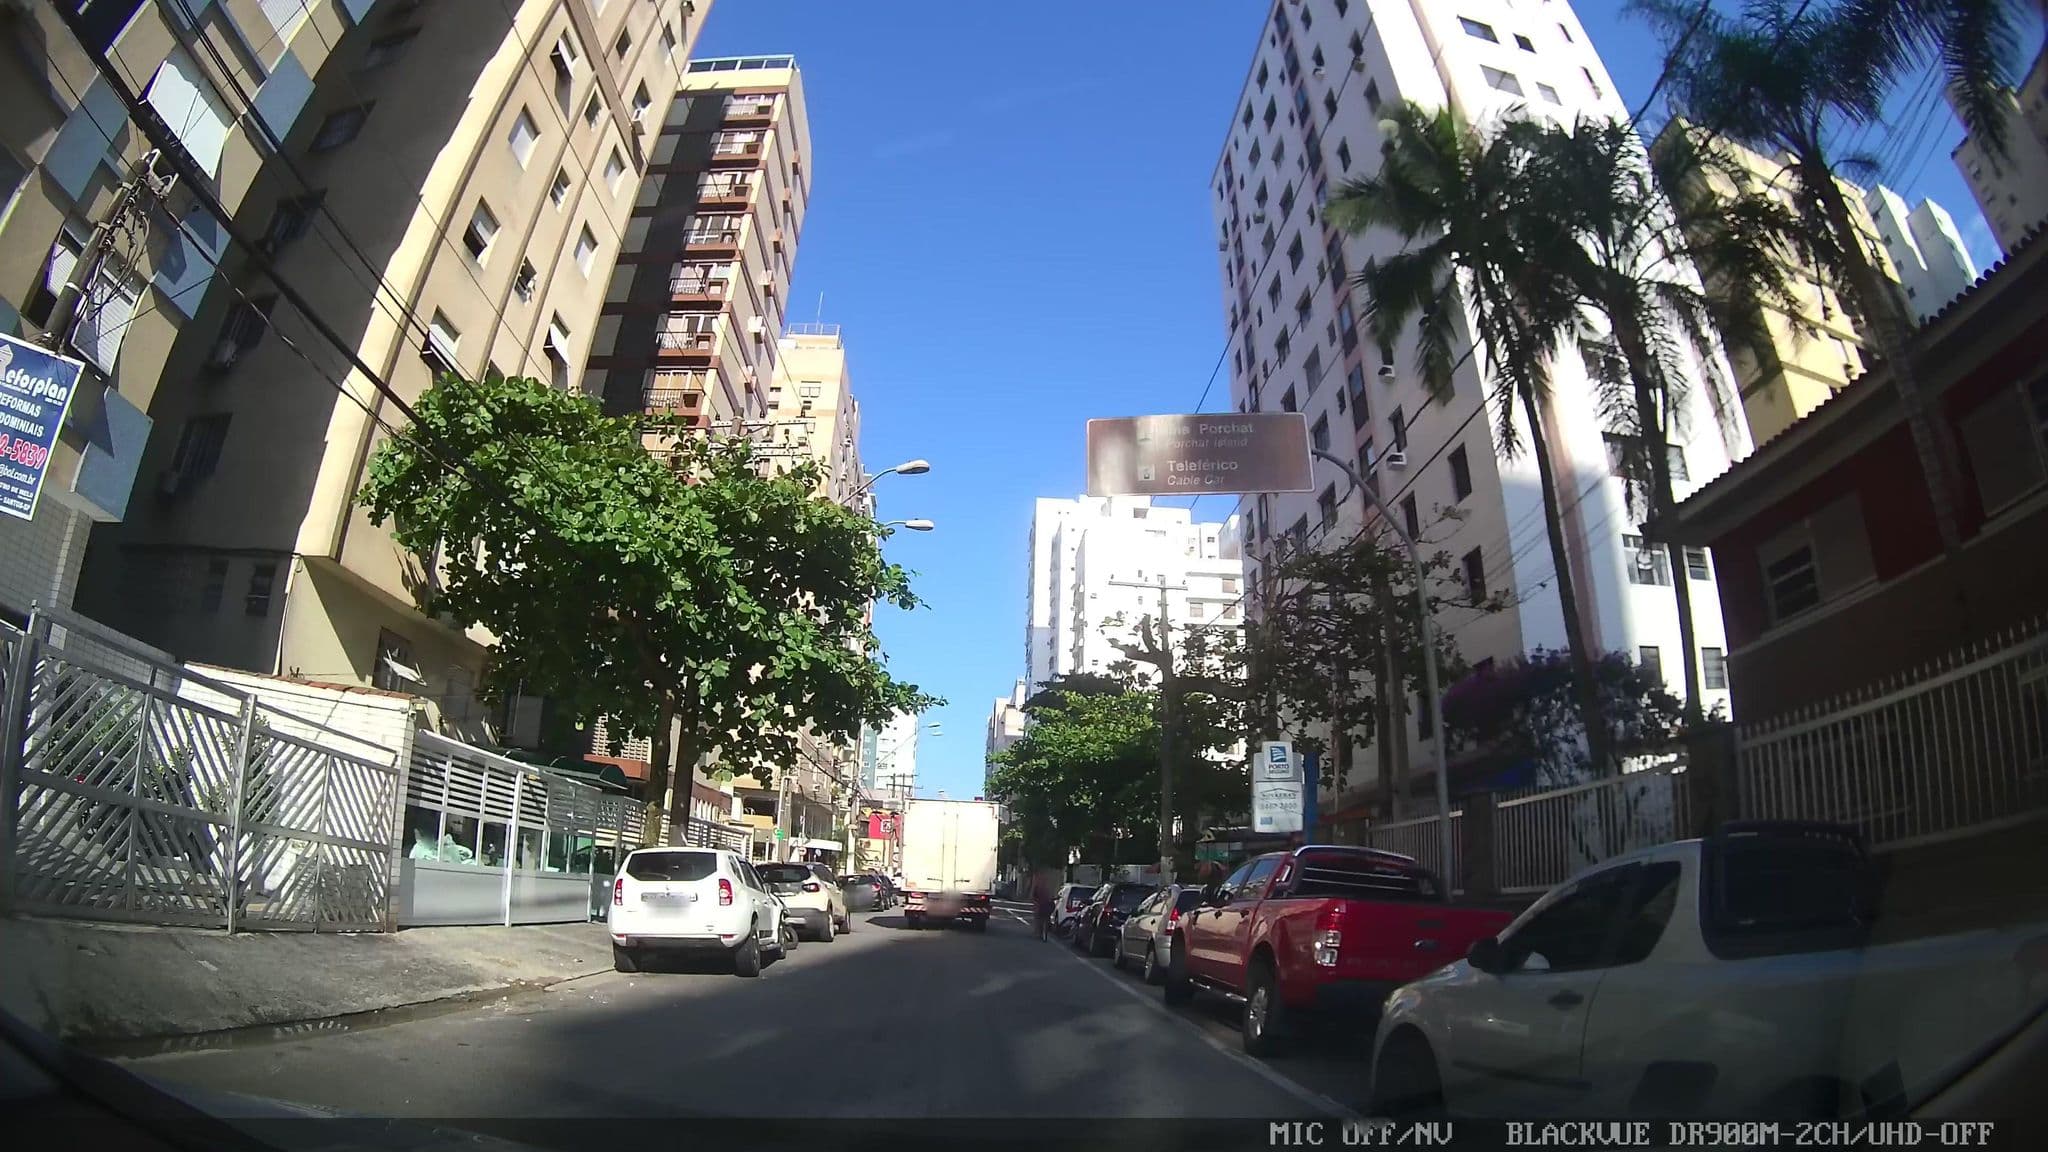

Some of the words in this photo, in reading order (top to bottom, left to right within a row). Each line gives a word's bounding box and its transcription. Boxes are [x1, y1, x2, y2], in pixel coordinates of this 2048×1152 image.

[1199, 423, 1254, 435] Porchat
[1167, 459, 1238, 472] Teleférico
[1167, 474, 1201, 486] Cable
[1204, 474, 1225, 486] Car
